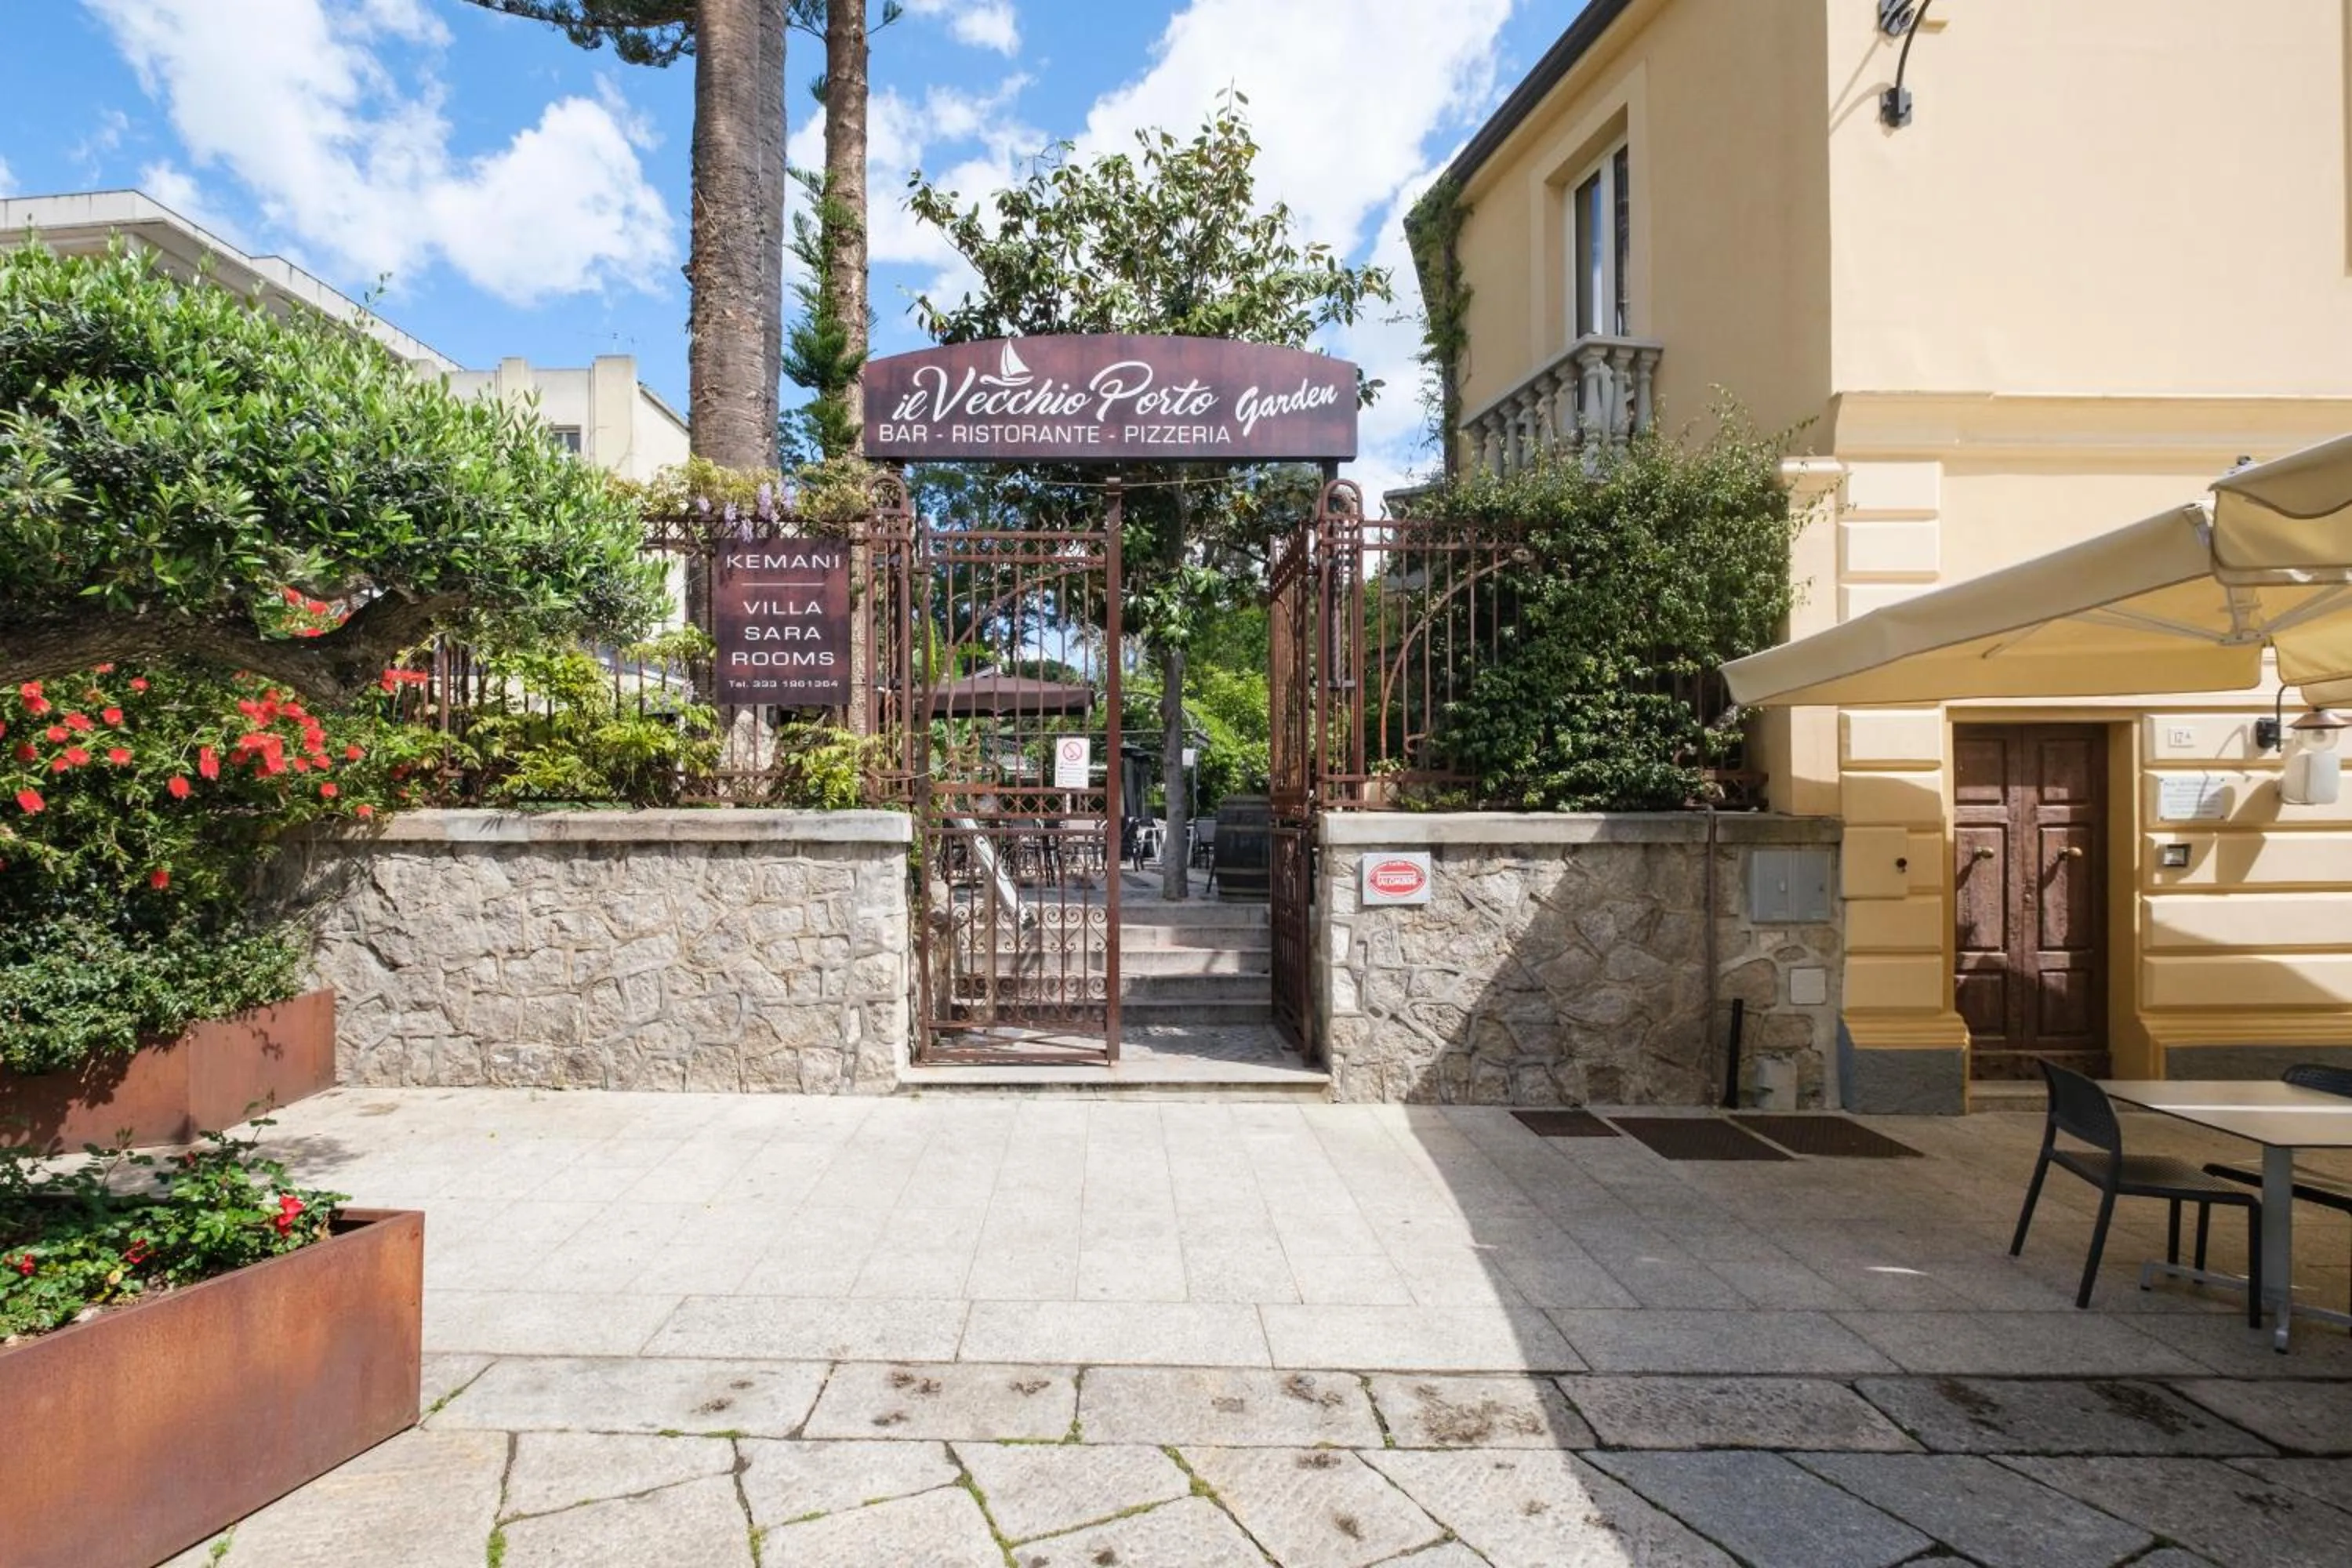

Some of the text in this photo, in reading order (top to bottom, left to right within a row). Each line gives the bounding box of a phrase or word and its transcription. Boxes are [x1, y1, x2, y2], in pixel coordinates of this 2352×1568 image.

[912, 365, 1092, 423] Vecchio
[1088, 360, 1220, 423] Porto
[1235, 377, 1339, 437] Garden
[879, 424, 927, 443] BAR
[952, 424, 1101, 444] RISTORANTE
[1124, 424, 1232, 444] PIZZERIA
[727, 554, 840, 568] KEMANI
[742, 601, 823, 615] VILLA
[744, 626, 822, 641] SARA
[731, 652, 836, 666] ROOMS
